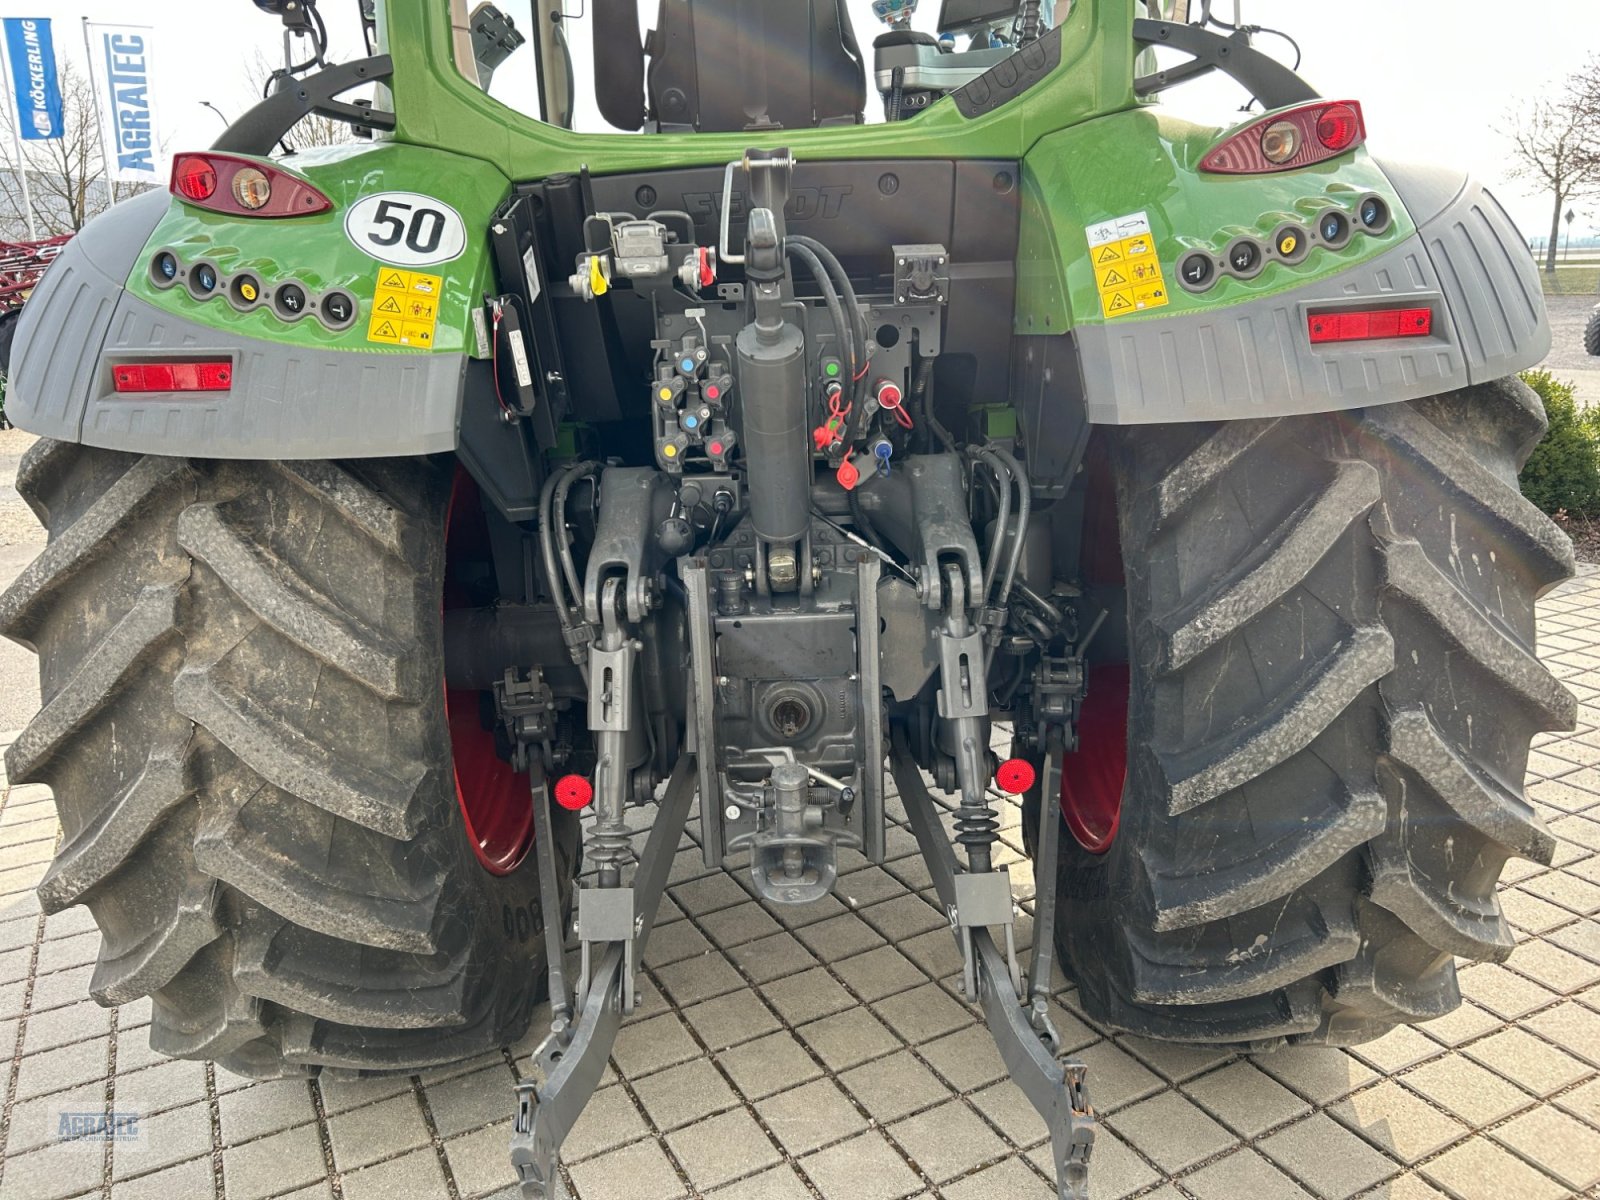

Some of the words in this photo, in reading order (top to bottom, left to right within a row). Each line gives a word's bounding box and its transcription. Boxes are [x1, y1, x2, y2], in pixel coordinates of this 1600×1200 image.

[22, 20, 47, 110] KÖCKERLING
[103, 33, 155, 173] AGRATEC
[367, 200, 446, 253] 50
[681, 184, 854, 225] FEDT
